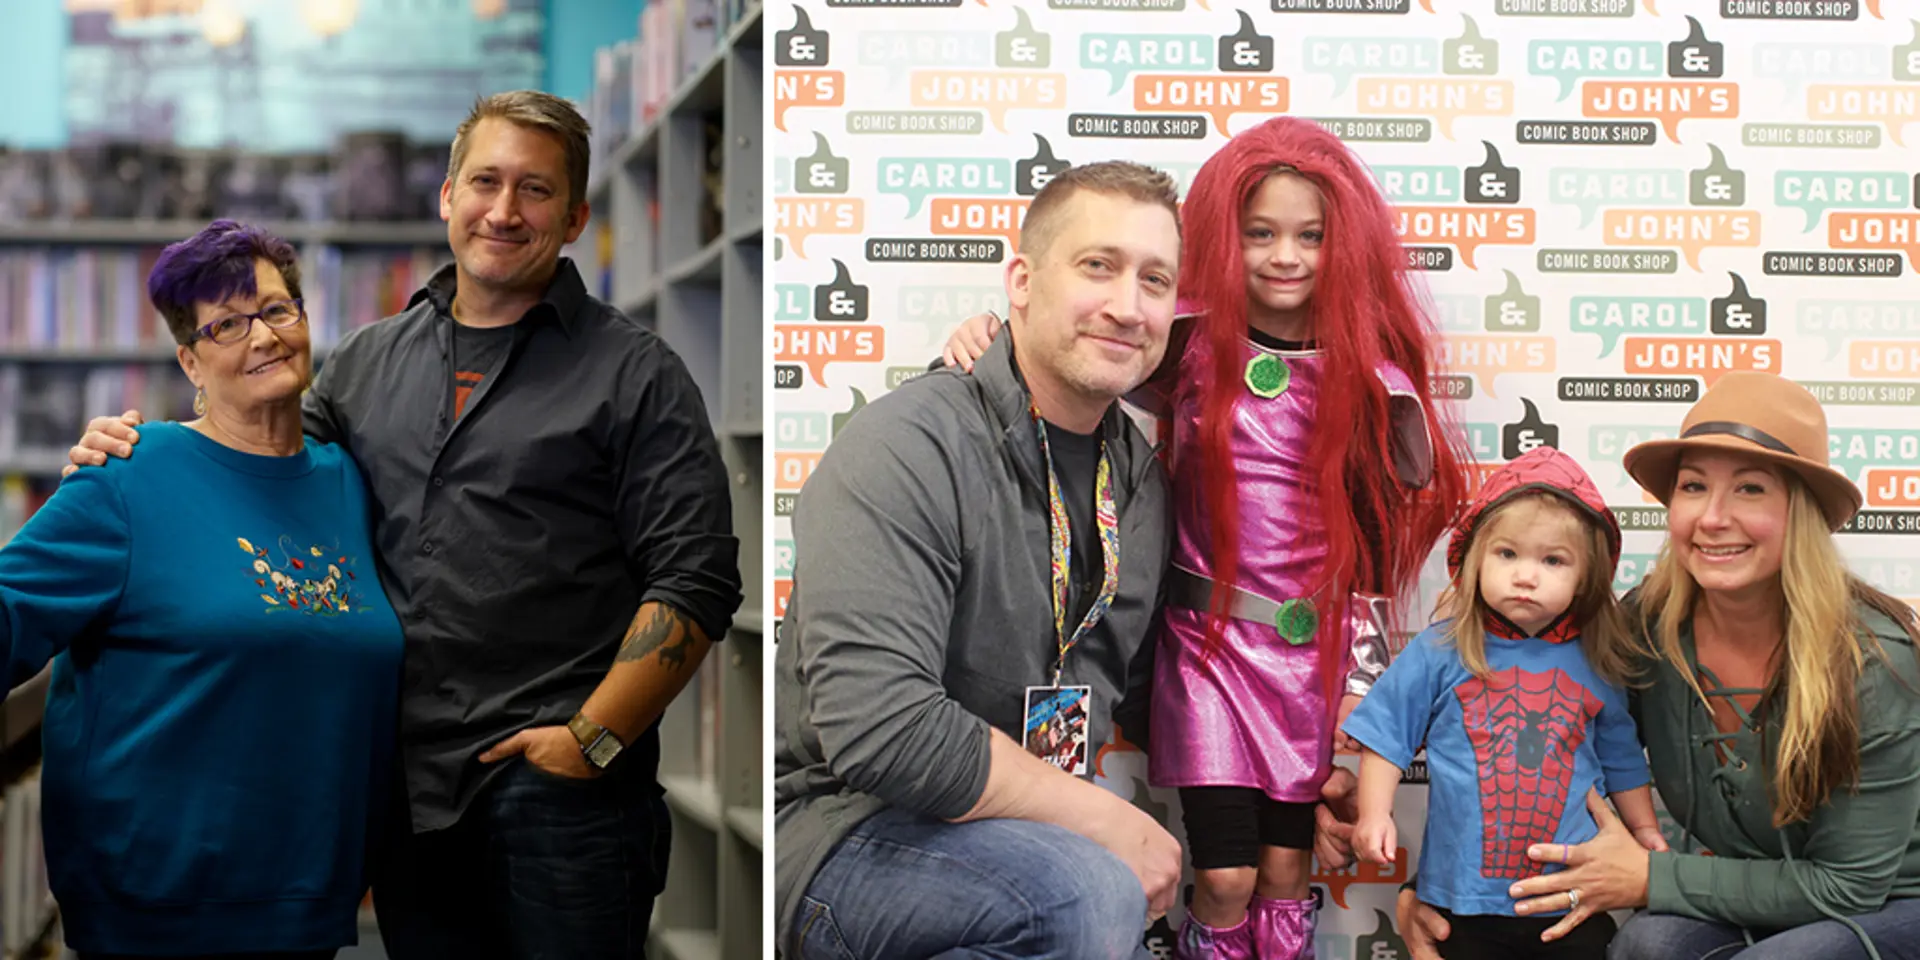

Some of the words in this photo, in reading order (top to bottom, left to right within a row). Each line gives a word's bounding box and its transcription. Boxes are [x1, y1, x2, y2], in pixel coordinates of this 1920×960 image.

[1502, 0, 1546, 12] COMIC
[1550, 0, 1587, 12] BOOK
[1591, 0, 1627, 13] SHOP
[1727, 1, 1771, 14] COMIC
[1775, 1, 1812, 15] BOOK
[1816, 2, 1852, 16] SHOP
[789, 36, 815, 60] &
[1010, 37, 1037, 62] &
[1088, 40, 1206, 65] CAROL
[1233, 42, 1260, 66] &
[1312, 43, 1432, 68] CAROL
[1458, 44, 1485, 69] &
[1536, 46, 1655, 70] CAROL
[1682, 47, 1710, 71] &
[920, 75, 1056, 100] JOHN'S
[1144, 80, 1280, 107] JOHN'S
[1367, 83, 1504, 109] JOHN'S
[1593, 86, 1729, 112] JOHN'S
[853, 116, 898, 130] COMIC
[901, 116, 937, 130] BOOK
[940, 116, 976, 131] SHOP
[1075, 118, 1119, 133] COMIC
[1123, 119, 1160, 134] BOOK
[1163, 119, 1199, 135] SHOP
[1347, 122, 1383, 137] BOOK
[1387, 123, 1424, 138] SHOP
[1523, 125, 1567, 140] COMIC
[1572, 126, 1609, 141] BOOK
[1613, 127, 1649, 142] SHOP
[1749, 128, 1793, 143] COMIC
[1797, 129, 1833, 144] BOOK
[1837, 130, 1873, 145] SHOP
[809, 163, 836, 187] &
[886, 163, 1004, 188] CAROL
[1384, 171, 1452, 196] ROL
[1479, 172, 1506, 197] &
[1558, 174, 1677, 199] CAROL
[1704, 175, 1731, 200] &
[1783, 177, 1902, 202] CAROL
[942, 204, 1027, 229] JOH
[1391, 212, 1525, 238] JOHN'S
[1614, 214, 1750, 240] JOHN'S
[1839, 218, 1920, 243] JOH
[873, 243, 916, 257] COMIC
[920, 243, 956, 258] BOOK
[959, 244, 996, 259] SHOP
[1408, 251, 1445, 266] SHOP
[1544, 253, 1588, 268] COMIC
[1593, 254, 1630, 269] BOOK
[1634, 255, 1670, 270] SHOP
[1770, 256, 1814, 271] COMIC
[1818, 257, 1854, 272] BOOK
[1858, 258, 1895, 273] SHOP
[829, 291, 855, 315] &
[905, 292, 1001, 316] CARO
[1500, 301, 1527, 326] &
[1579, 302, 1698, 327] CAROL
[1725, 303, 1752, 328] &
[1635, 342, 1771, 369] JOHN'S
[1428, 381, 1465, 395] SHOP
[1565, 383, 1609, 397] COMIC
[1613, 384, 1651, 398] BOOK
[1655, 384, 1692, 399] SHOP
[1840, 386, 1876, 401] BOOK
[1880, 387, 1916, 402] SHOP
[1632, 511, 1668, 526] BOOK
[1857, 515, 1894, 530] BOOK
